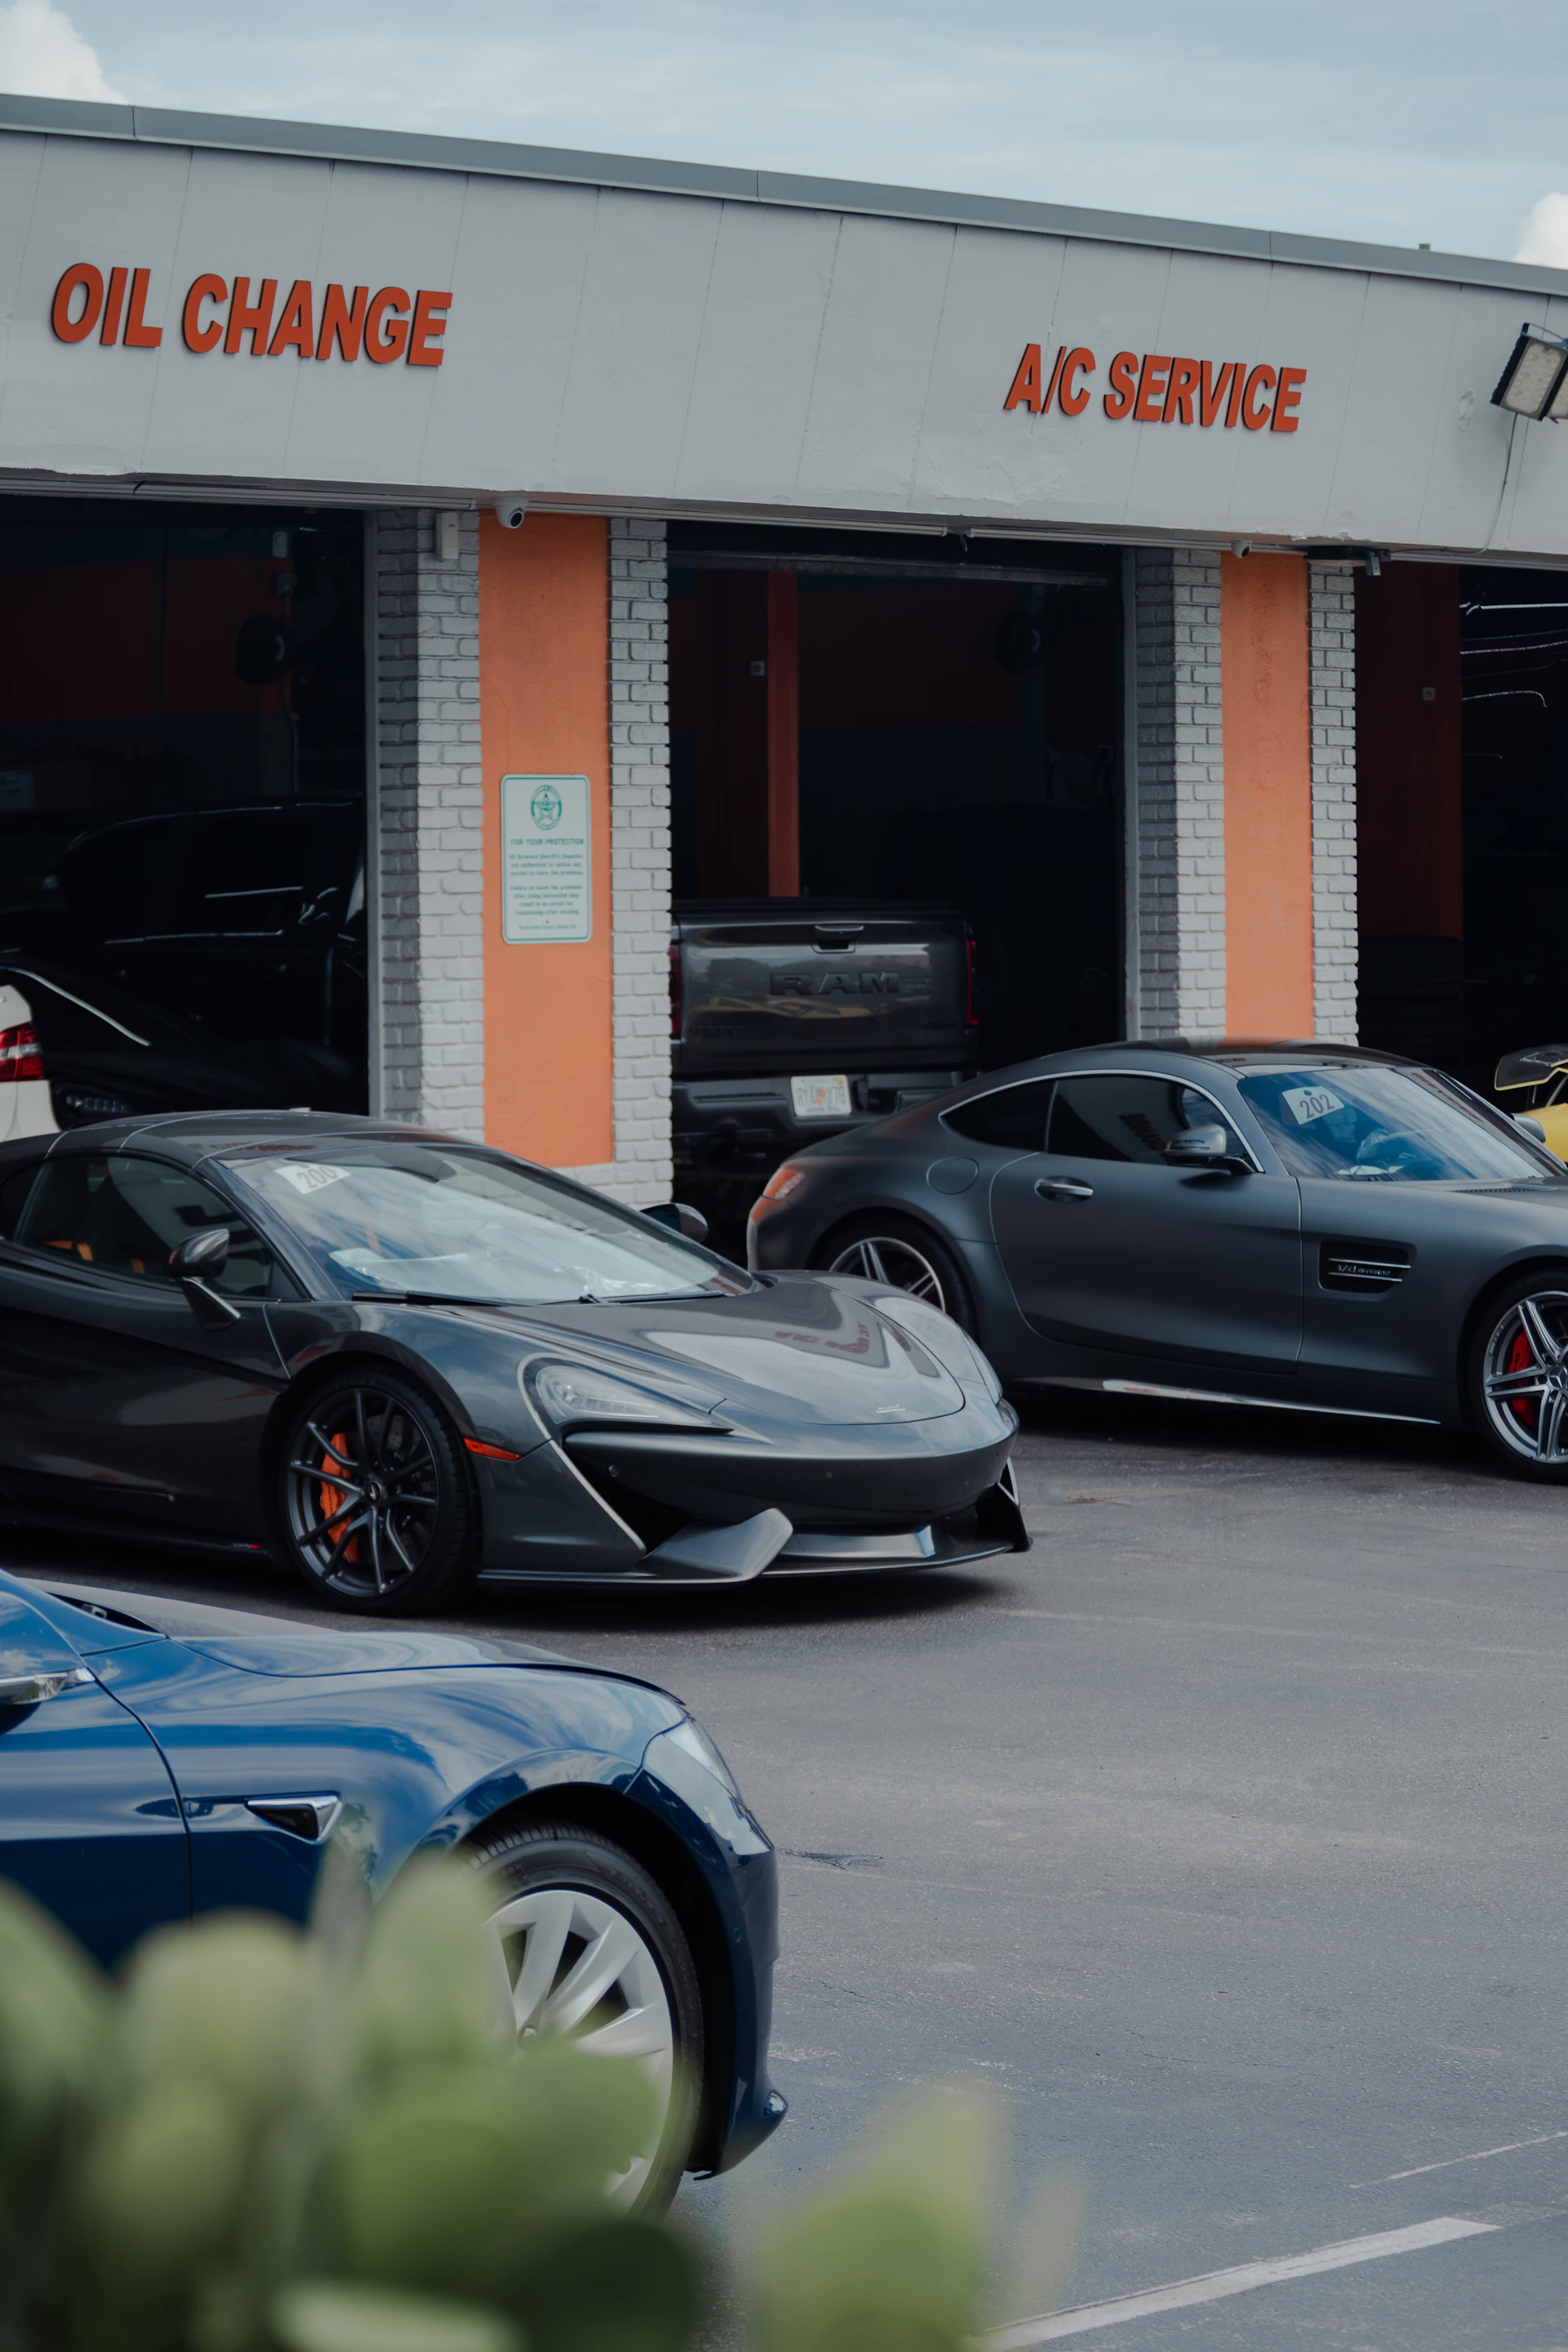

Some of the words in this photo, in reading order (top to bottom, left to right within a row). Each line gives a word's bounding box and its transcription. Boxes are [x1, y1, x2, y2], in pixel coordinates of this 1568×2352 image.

[51, 262, 163, 347] OIL
[182, 273, 453, 367] CHANGE
[1003, 343, 1096, 416] A/C
[1103, 351, 1307, 432] SERVICE
[769, 971, 901, 996] RAM
[1299, 1094, 1335, 1119] 202
[296, 1165, 338, 1190] 200
